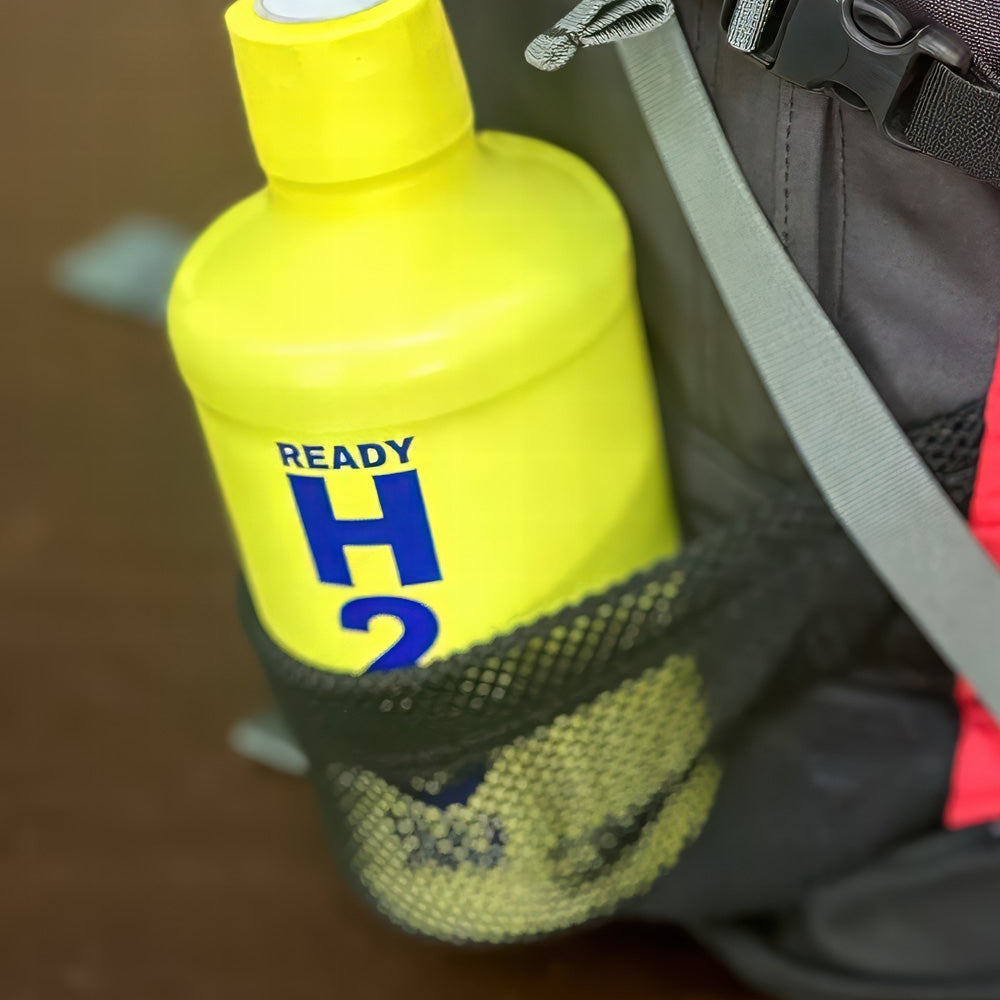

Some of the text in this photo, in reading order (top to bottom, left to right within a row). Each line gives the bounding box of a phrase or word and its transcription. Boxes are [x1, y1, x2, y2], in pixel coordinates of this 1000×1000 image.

[276, 436, 416, 470] READY
[286, 468, 443, 587] H
[339, 595, 441, 674] 2
